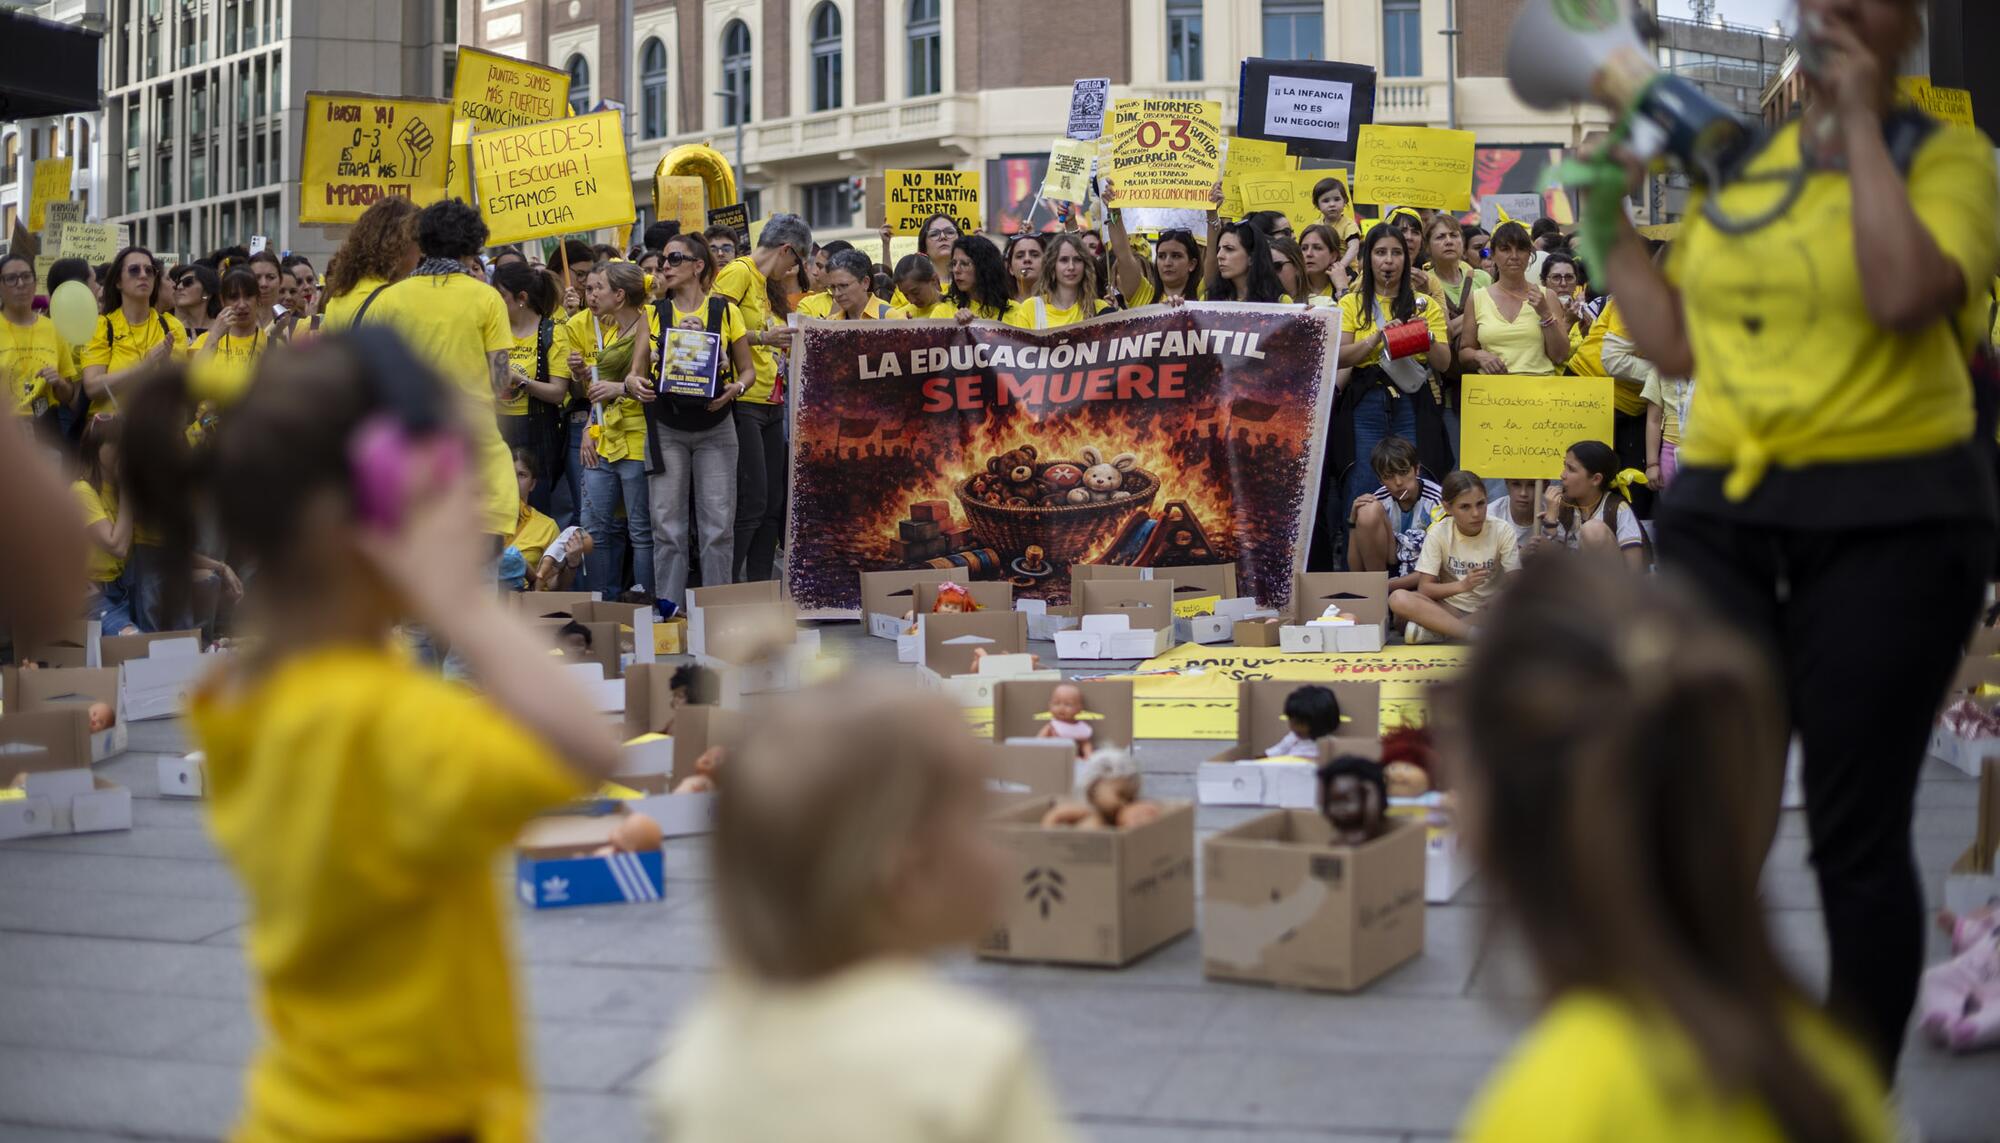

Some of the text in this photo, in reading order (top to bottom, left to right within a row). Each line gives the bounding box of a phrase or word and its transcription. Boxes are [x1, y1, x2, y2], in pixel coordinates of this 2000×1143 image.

[525, 72, 551, 93] SOMOS
[485, 84, 554, 117] MÁS FUERTES!
[1283, 87, 1296, 96] LA
[1298, 89, 1344, 101] INFANCIA
[1293, 103, 1323, 113] NO ES
[1274, 116, 1340, 129] UN NEGOCIO!!
[353, 127, 381, 148] 0-3
[1136, 119, 1192, 152] 0-3
[1365, 132, 1384, 149] POR
[342, 146, 381, 163] ES LA
[338, 162, 370, 177] ETAPA
[903, 172, 962, 187] NO HAY
[1124, 178, 1212, 187] MUCHA RESPONSABILIDAD
[489, 177, 597, 214] ESTAMOS EN
[891, 185, 977, 203] ALTERNATIVA
[1129, 188, 1150, 200] POCO
[527, 205, 574, 227] LUCHA
[858, 329, 1266, 380] LA EDUCACIÓN INFANTIL
[922, 364, 1187, 414] SE MUERE
[1504, 418, 1522, 430] la
